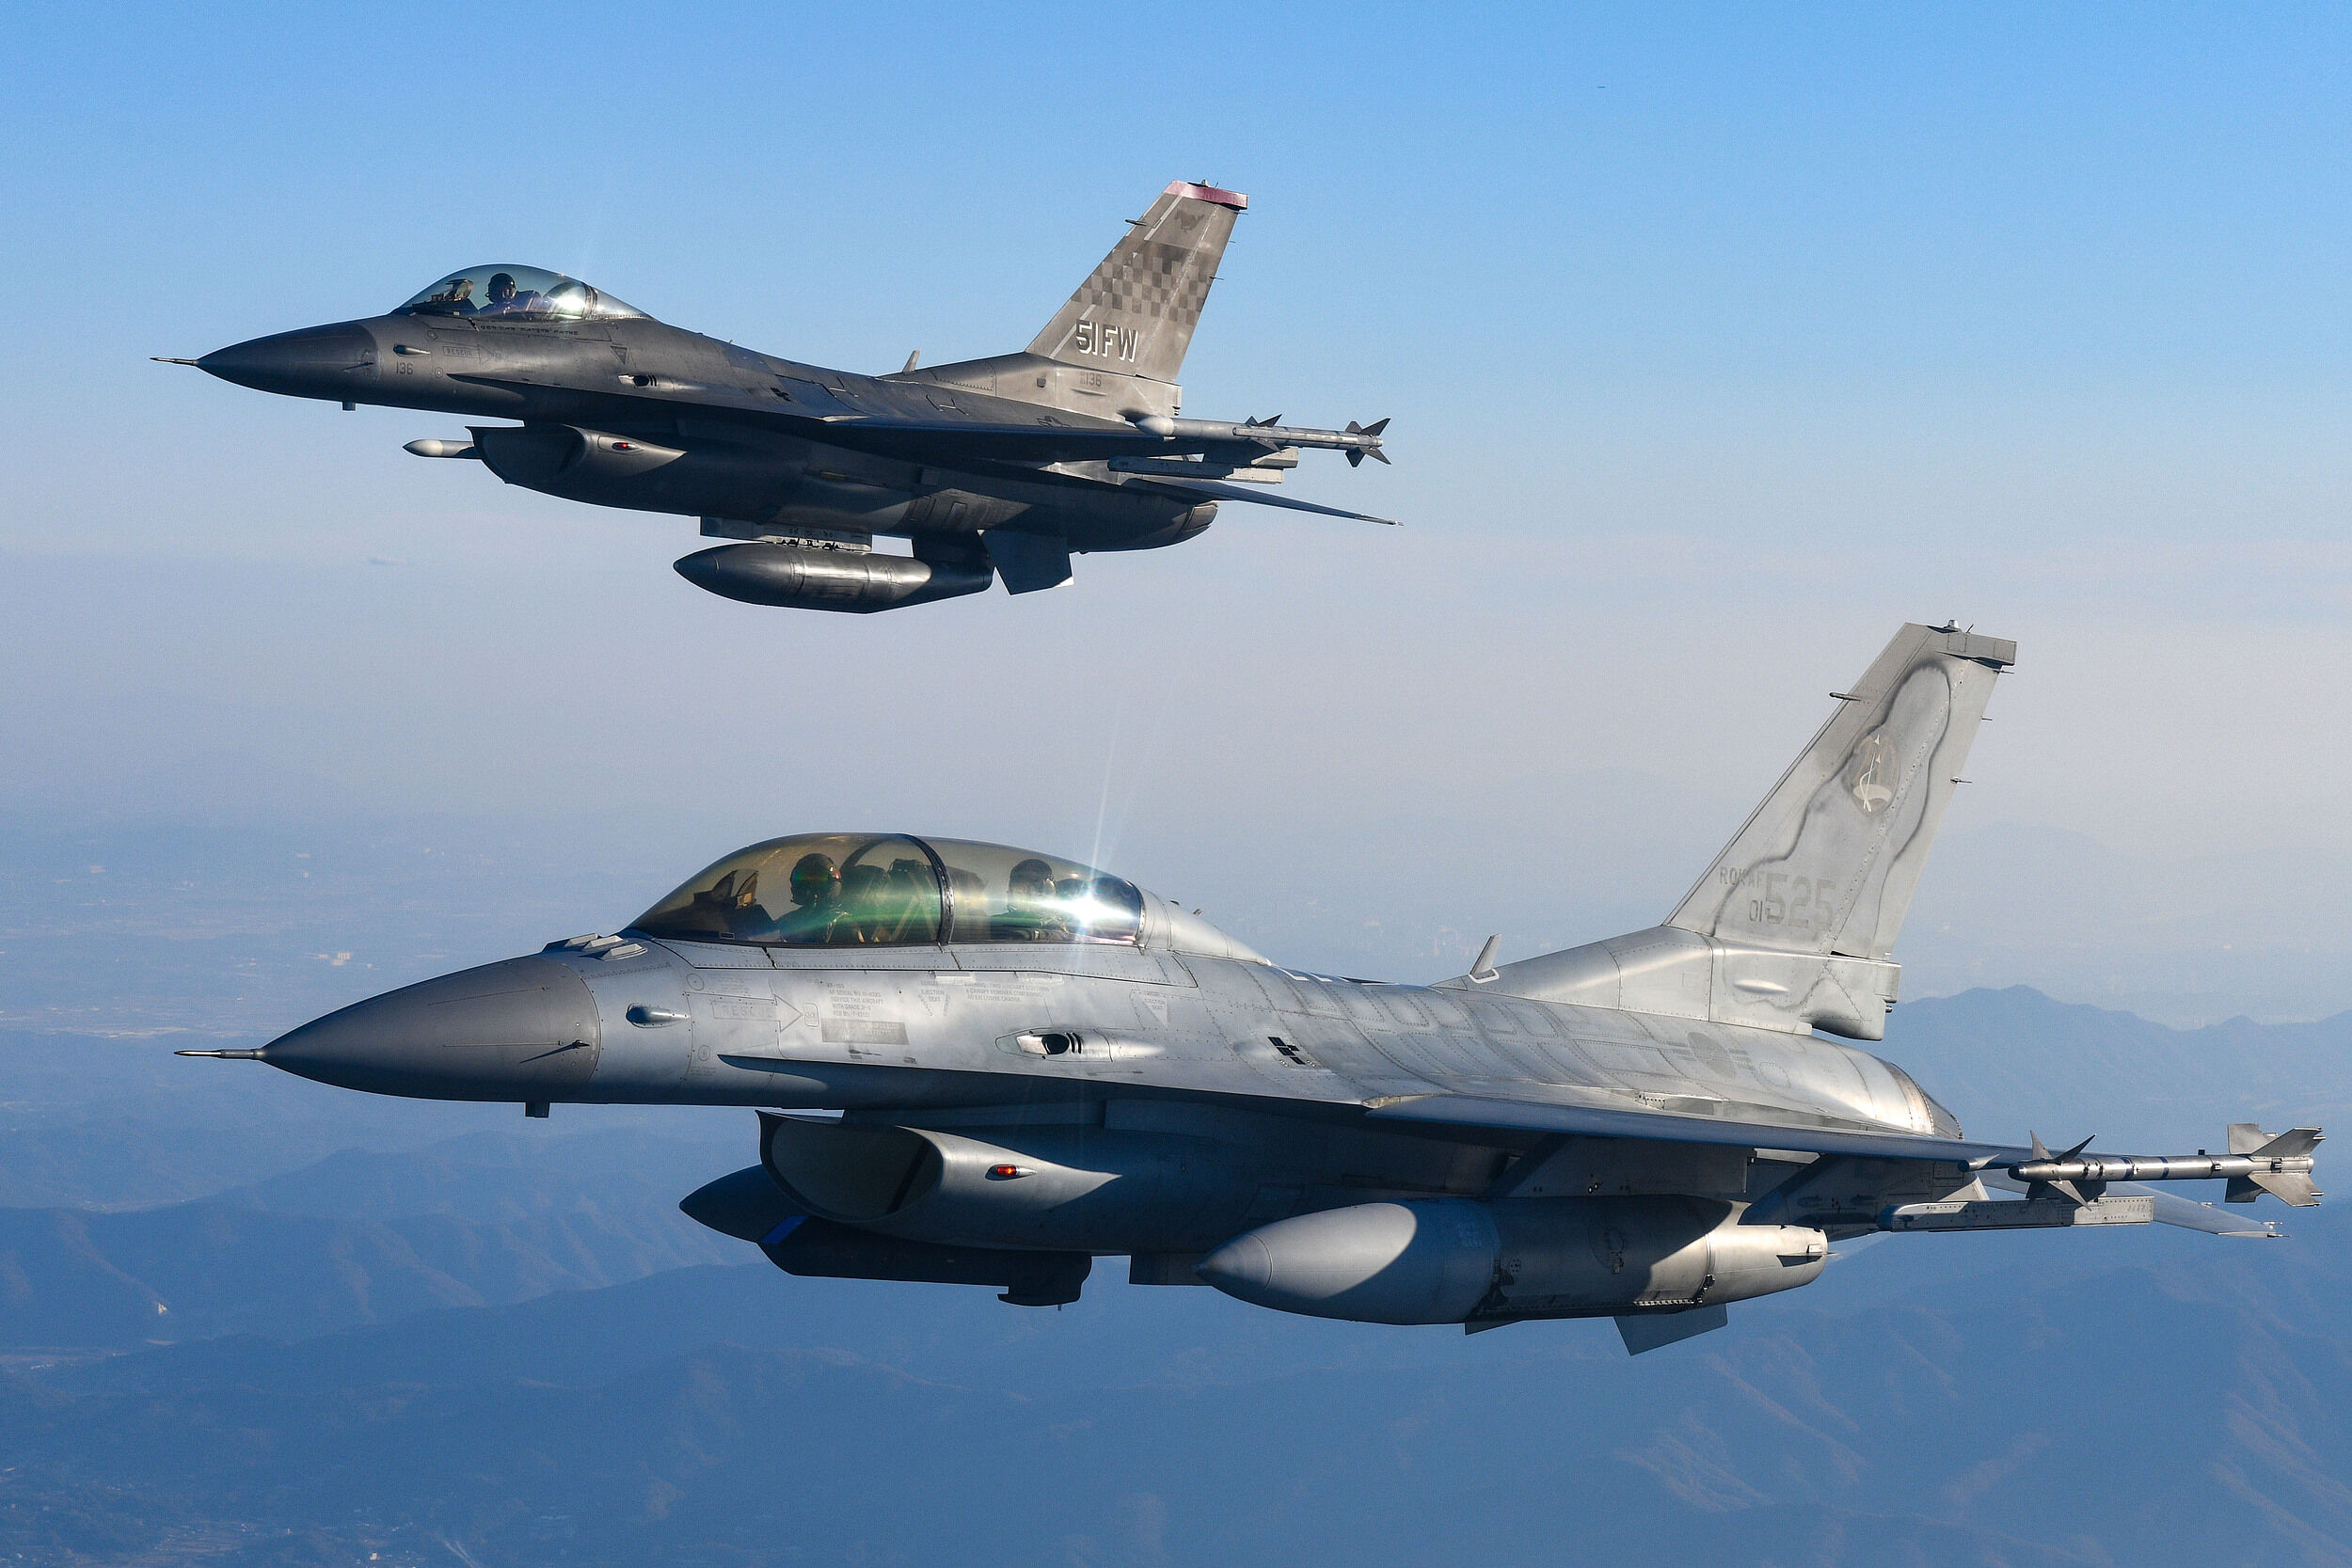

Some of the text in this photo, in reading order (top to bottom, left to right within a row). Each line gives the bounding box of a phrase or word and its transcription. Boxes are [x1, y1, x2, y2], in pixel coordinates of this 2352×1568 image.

[396, 360, 414, 375] 136
[1086, 372, 1103, 388] 136
[1720, 866, 1764, 888] ROKAF
[1765, 873, 1836, 930] 525
